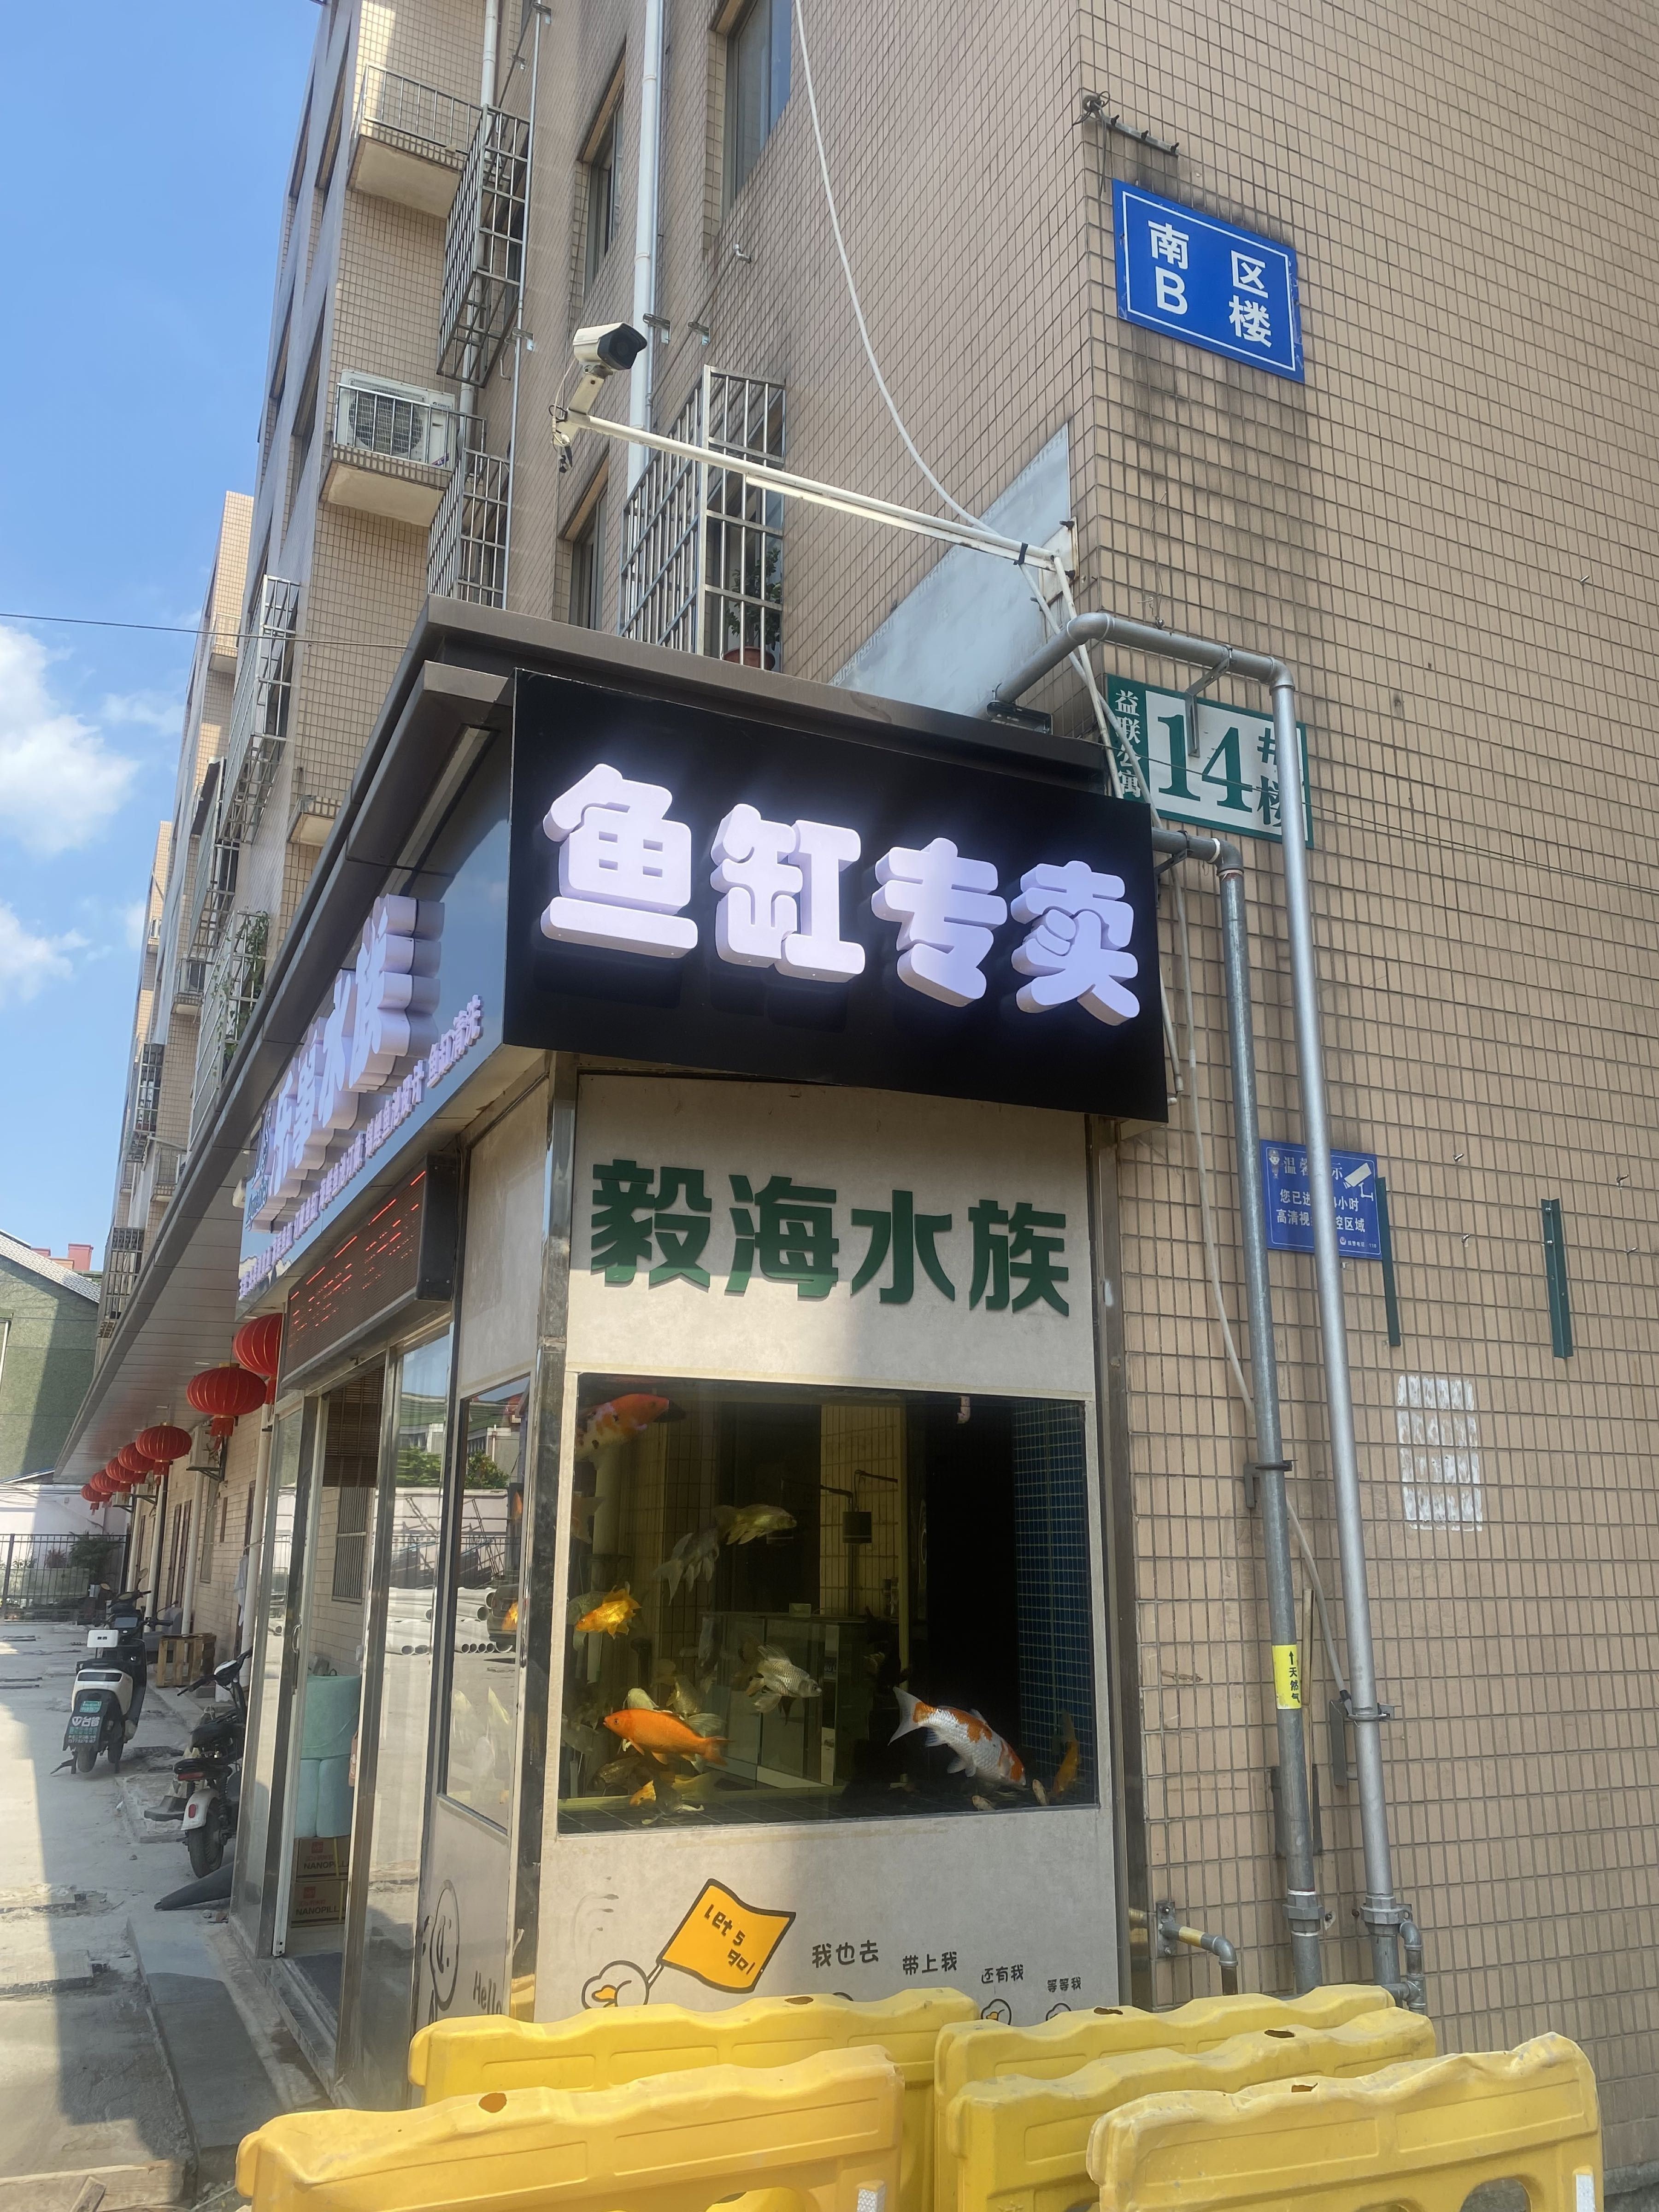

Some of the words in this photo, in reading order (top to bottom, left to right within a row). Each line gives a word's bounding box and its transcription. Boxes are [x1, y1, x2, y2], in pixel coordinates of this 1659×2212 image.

[1148, 220, 1268, 299] 南区
[1155, 266, 1271, 348] B楼
[1157, 714, 1253, 813] 14
[541, 763, 1141, 1027] 鱼缸专卖
[427, 994, 482, 1088] 鱼缸清洗
[1283, 1156, 1343, 1181] 温馨示
[1279, 1188, 1359, 1212] 您已进小时
[590, 1159, 1069, 1317] 毅海水族
[1276, 1208, 1365, 1233] 高清视控区域
[1289, 1667, 1300, 1703] 天然气
[812, 1939, 879, 1969] 我也去
[902, 1951, 957, 1976] 带上我
[981, 1964, 1024, 1984] 还有我
[1047, 1976, 1082, 1993] 等等我
[472, 1970, 502, 2015] Hello
